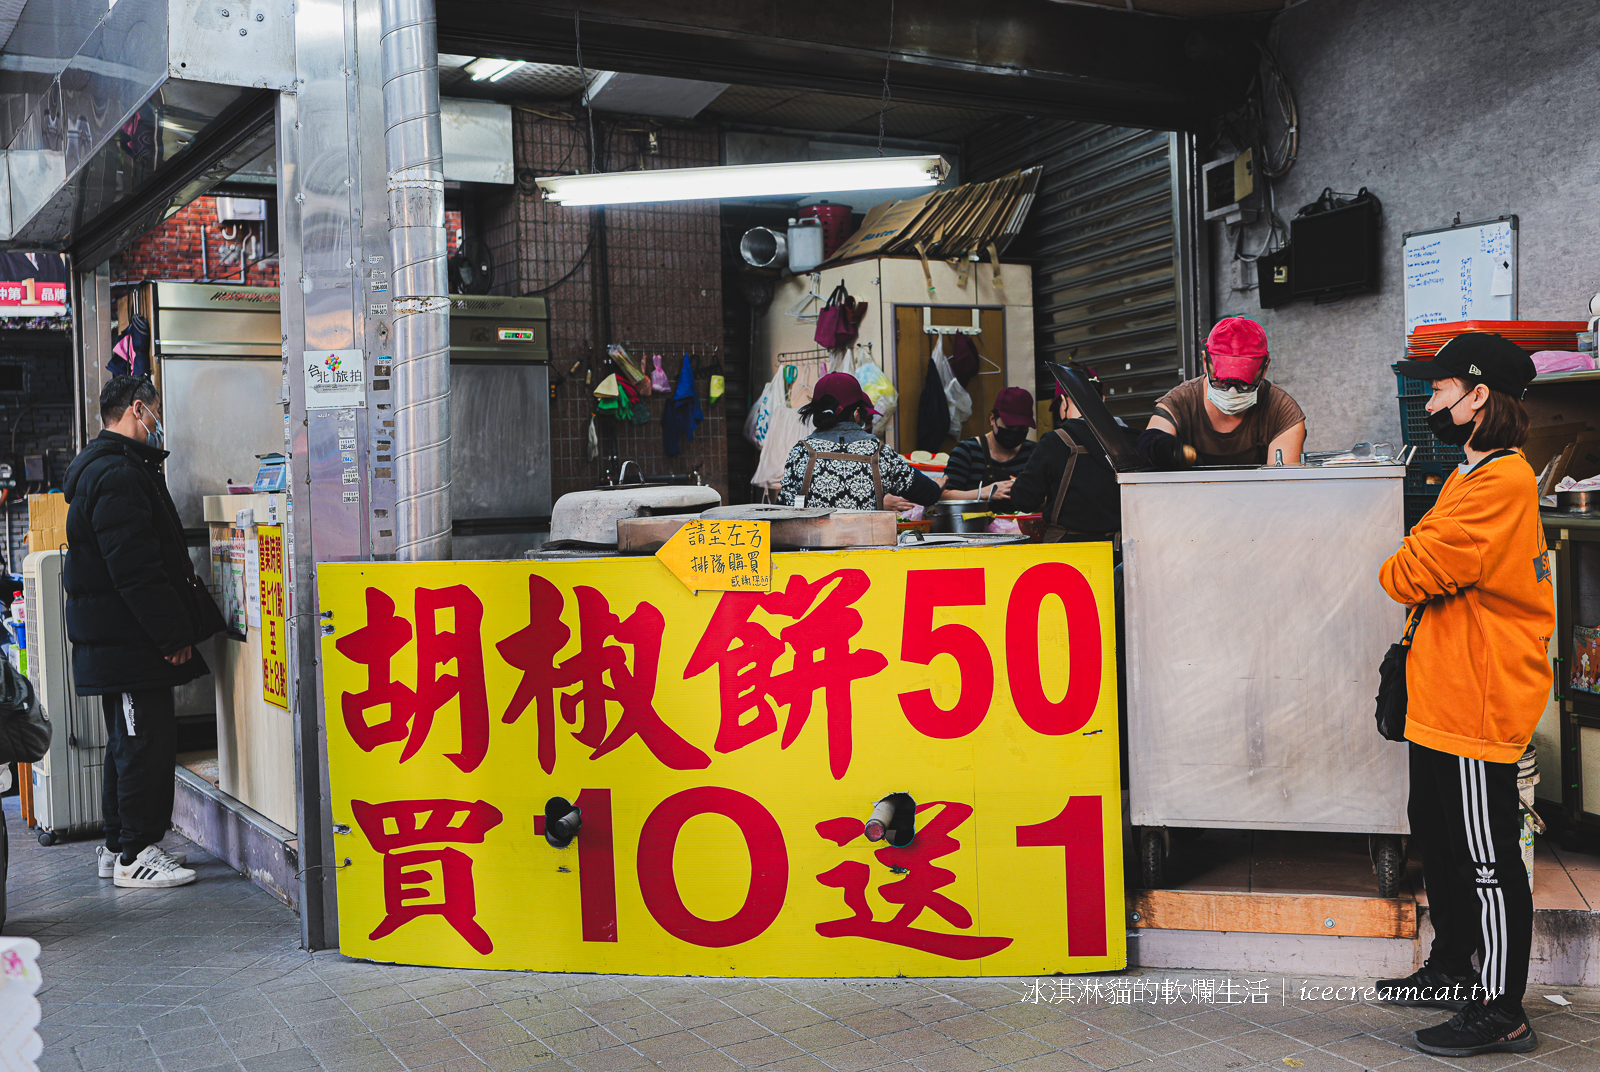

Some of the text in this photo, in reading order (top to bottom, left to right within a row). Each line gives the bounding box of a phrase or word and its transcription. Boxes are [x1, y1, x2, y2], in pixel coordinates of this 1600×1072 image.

[308, 364, 363, 384] 台北旅拍
[685, 522, 762, 548] 請至左方
[259, 534, 282, 574] 營業時間
[690, 551, 760, 574] 排隊購買
[270, 620, 277, 655] 至
[1475, 876, 1498, 884] adidas
[1506, 1023, 1527, 1040] PUMA
